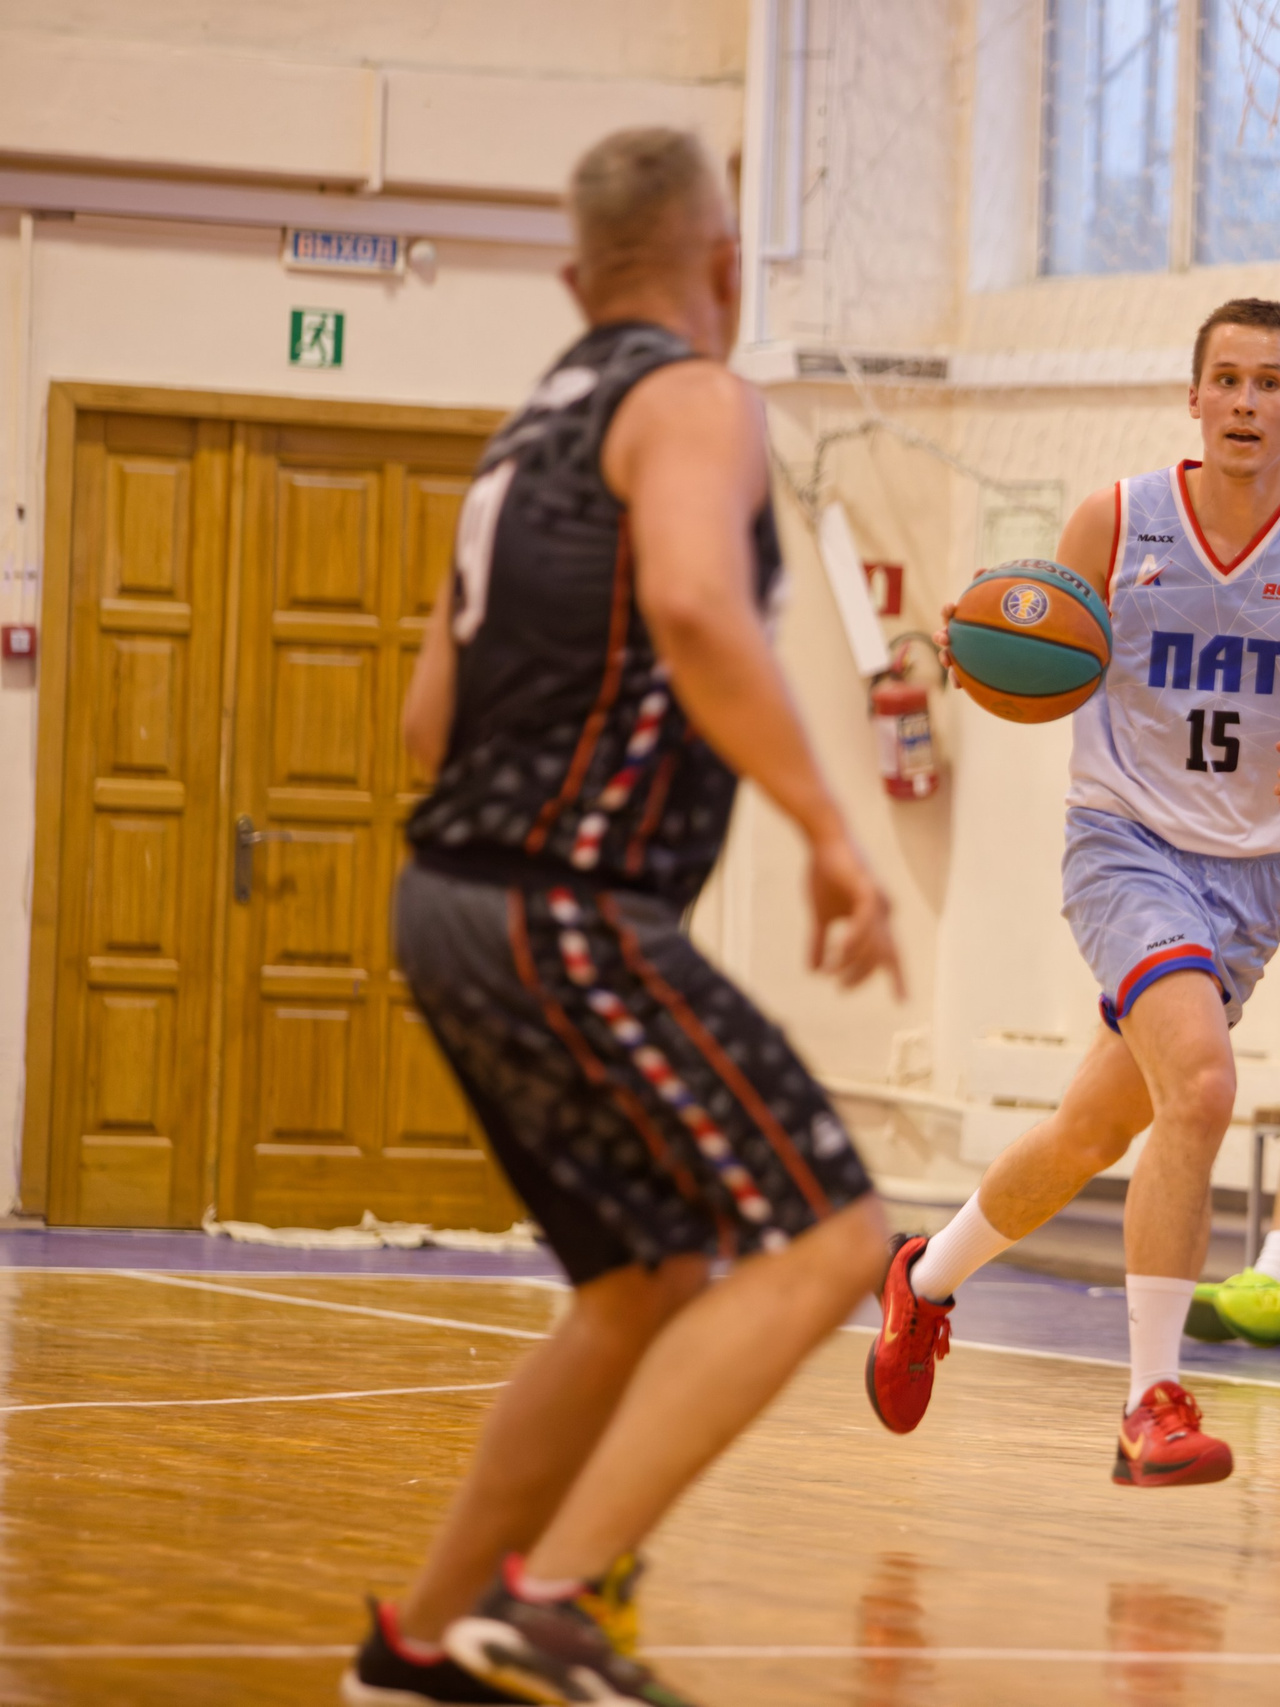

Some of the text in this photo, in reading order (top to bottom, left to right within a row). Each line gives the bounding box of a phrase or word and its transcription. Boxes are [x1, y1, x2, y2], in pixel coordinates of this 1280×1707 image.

[297, 231, 394, 267] ВЫХОД
[1137, 533, 1175, 544] MAXX
[1185, 708, 1241, 773] 15
[1146, 934, 1186, 951] MAXX
